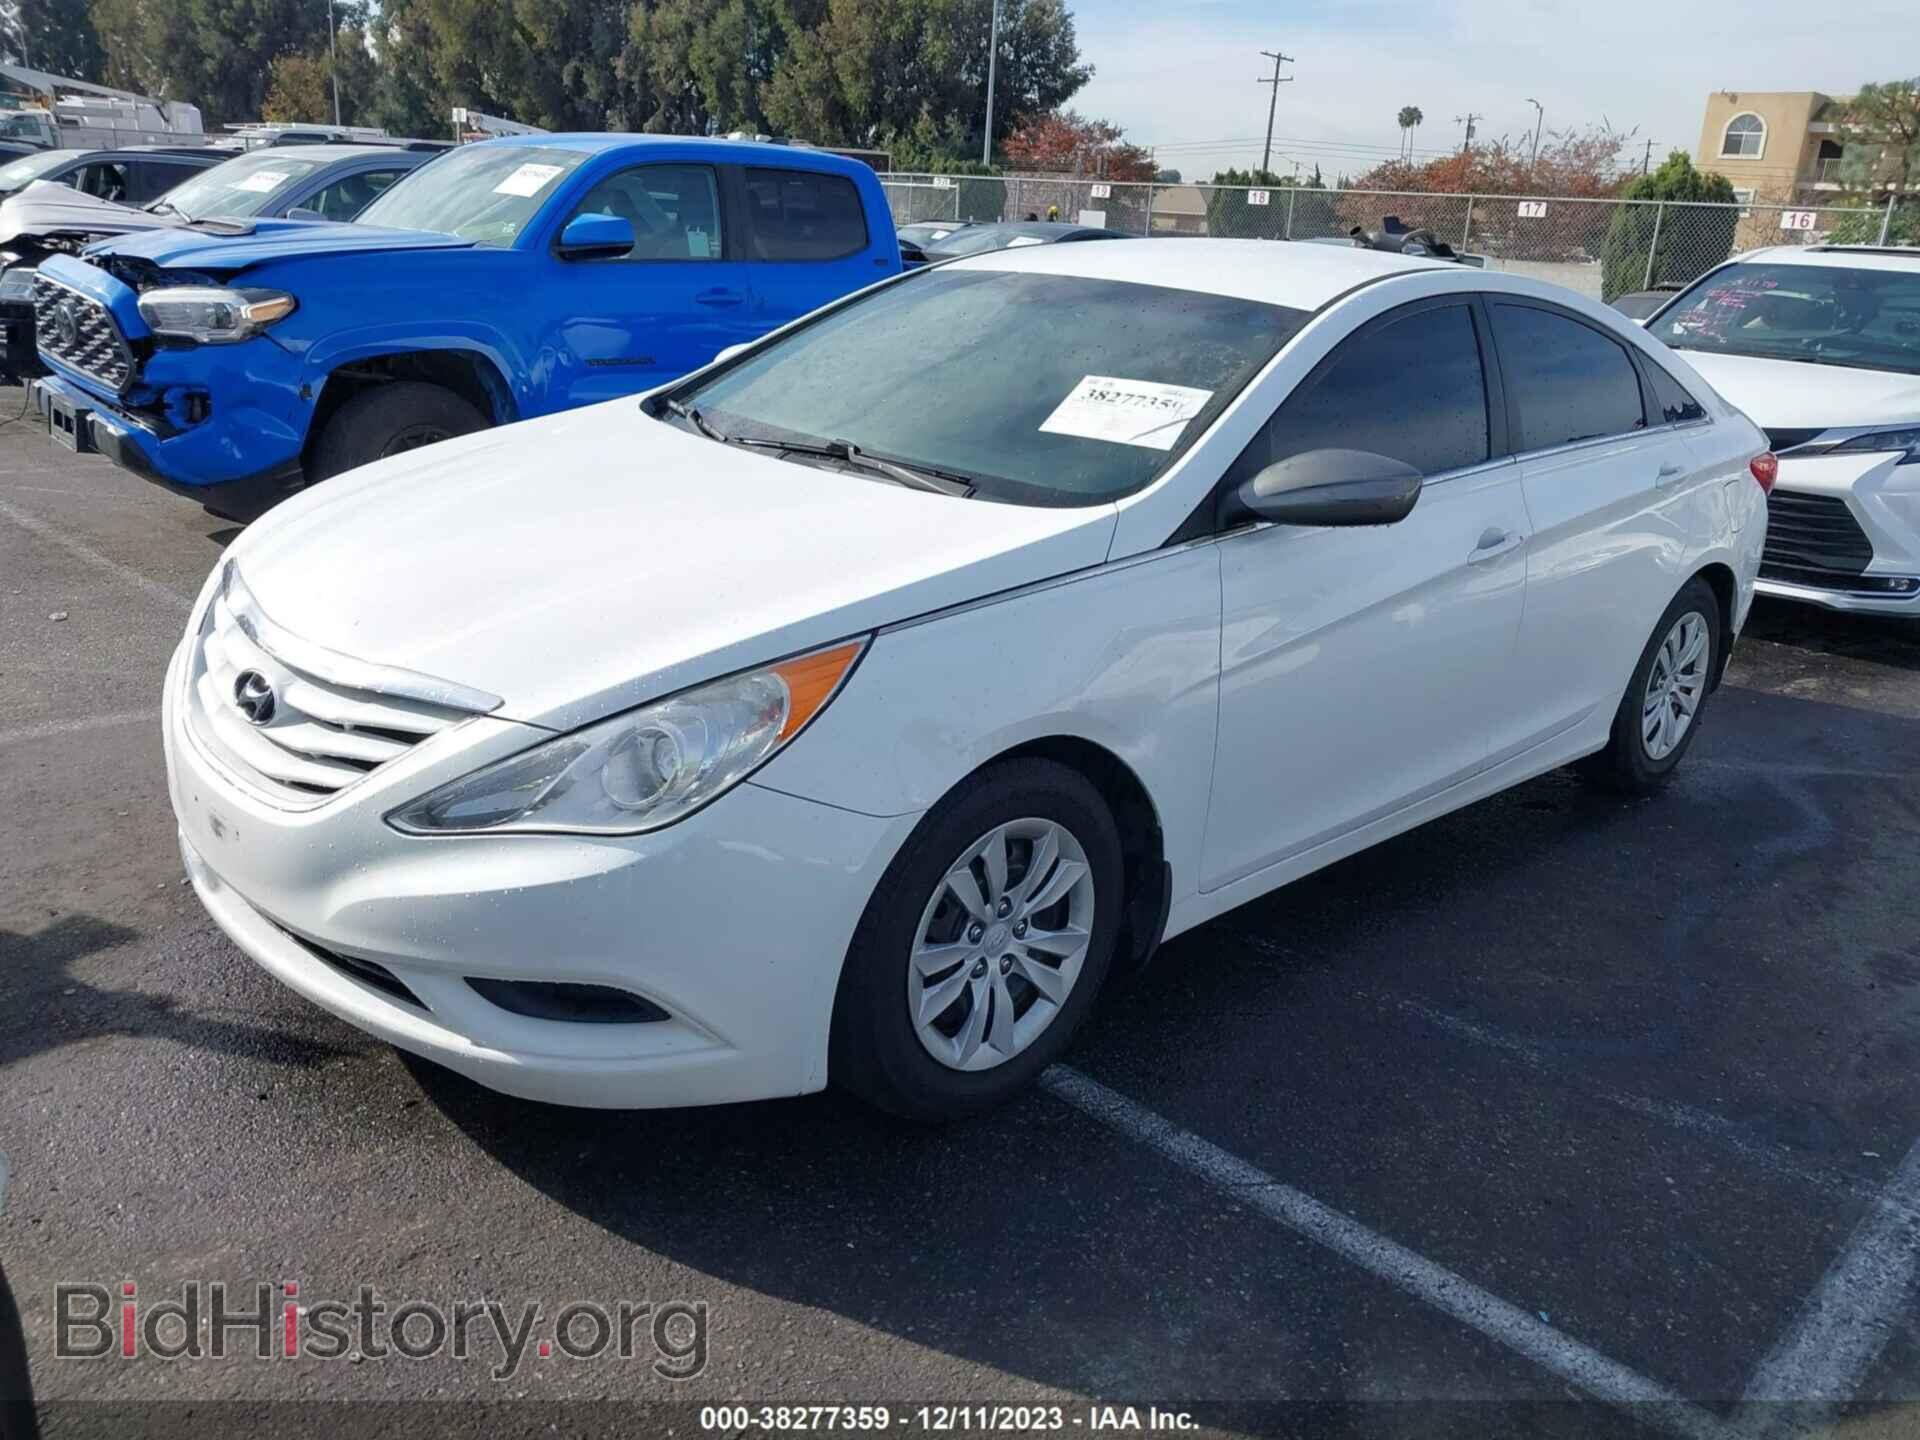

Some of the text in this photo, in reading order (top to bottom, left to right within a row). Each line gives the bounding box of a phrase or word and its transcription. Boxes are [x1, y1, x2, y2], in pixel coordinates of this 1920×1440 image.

[1253, 191, 1265, 203] 18
[1525, 203, 1542, 216] 17
[1790, 213, 1810, 228] 16
